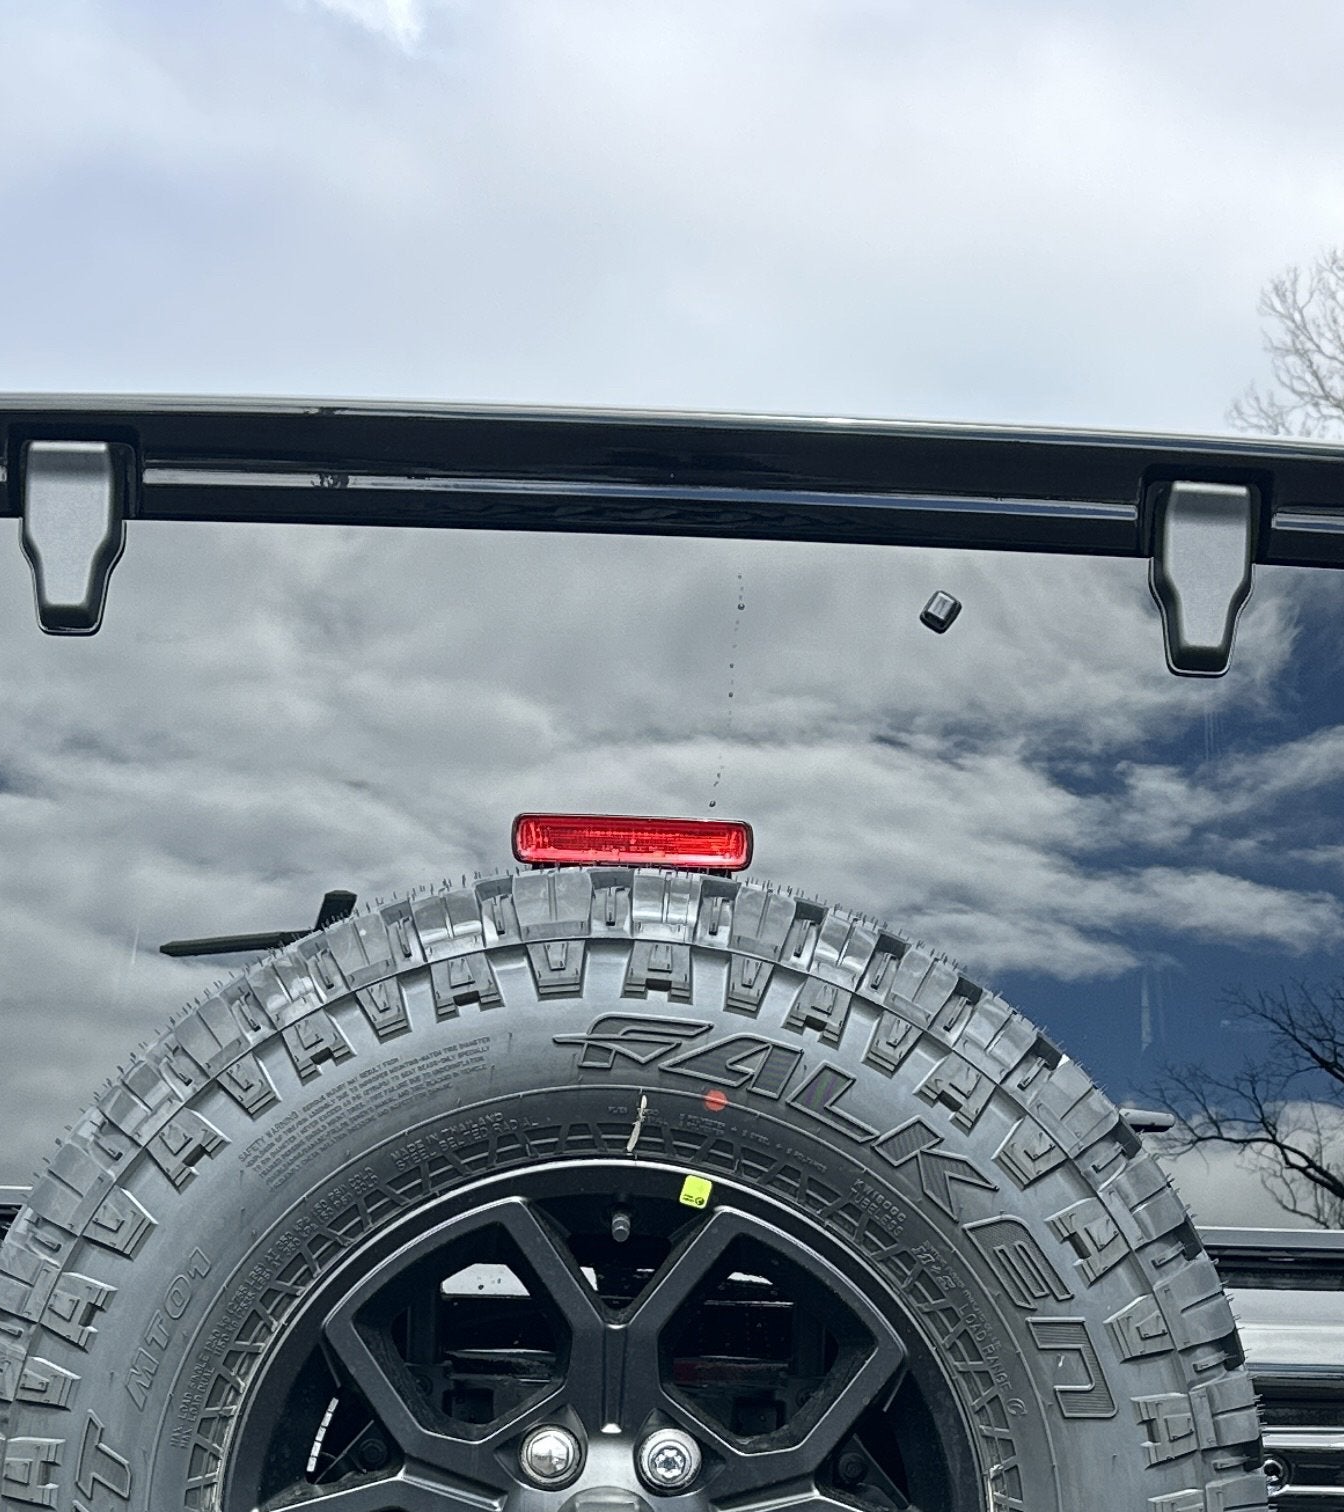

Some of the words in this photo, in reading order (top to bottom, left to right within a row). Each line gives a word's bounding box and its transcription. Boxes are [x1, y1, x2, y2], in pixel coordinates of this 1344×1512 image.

[389, 1136, 426, 1162] MADE
[424, 1131, 439, 1145] IN
[439, 1110, 505, 1139] THAILAND
[394, 1143, 438, 1172] STEEL
[437, 1124, 491, 1152] BELTED
[490, 1114, 541, 1134] RADIAL
[553, 1013, 1118, 1418] FALKEN
[845, 1185, 906, 1238] TUBELESS
[957, 1301, 988, 1342] LOAD
[981, 1342, 1012, 1393] RANGE
